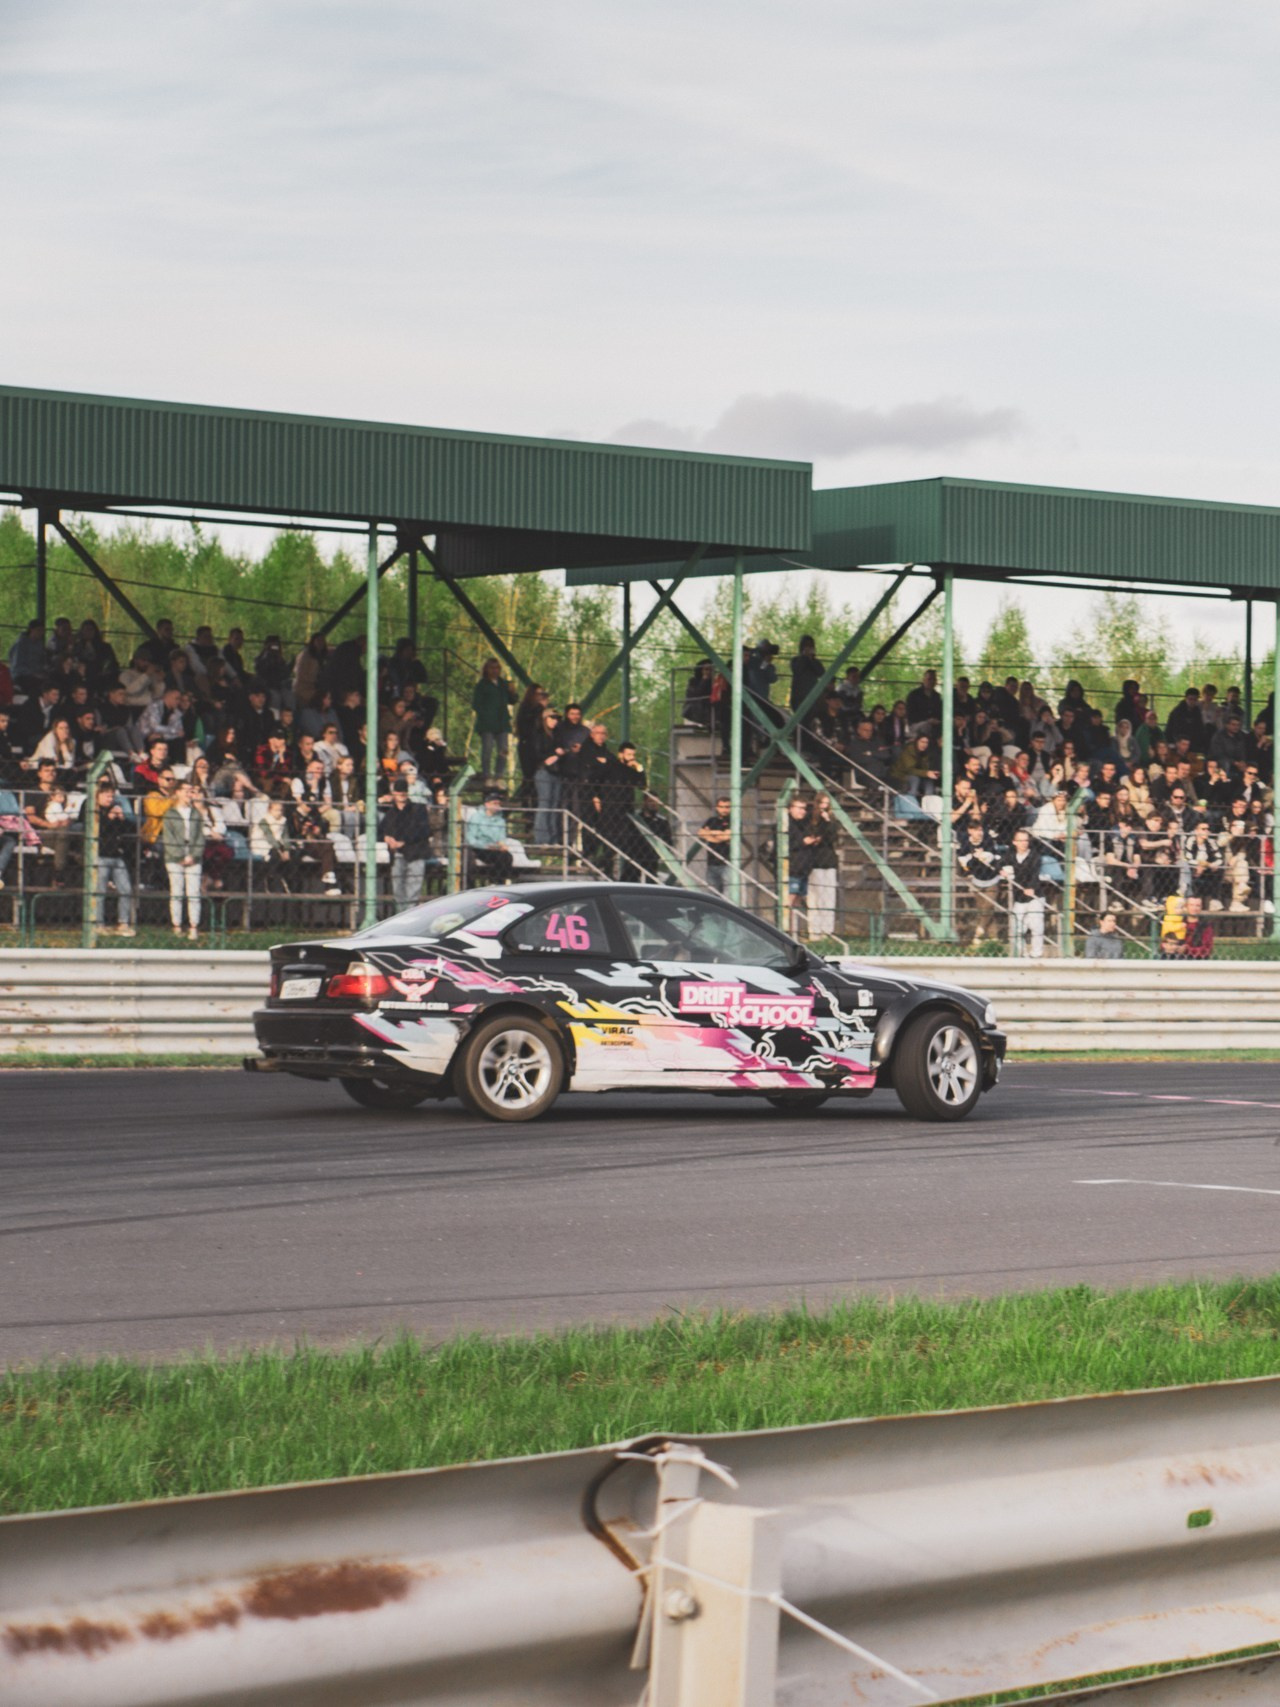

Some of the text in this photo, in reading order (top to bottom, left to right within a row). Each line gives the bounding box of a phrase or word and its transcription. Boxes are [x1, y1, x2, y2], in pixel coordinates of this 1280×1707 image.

[545, 913, 590, 950] 46
[682, 985, 744, 1005] DRIFT
[728, 1005, 815, 1026] SCHOOL
[602, 1026, 634, 1035] VIRAG
